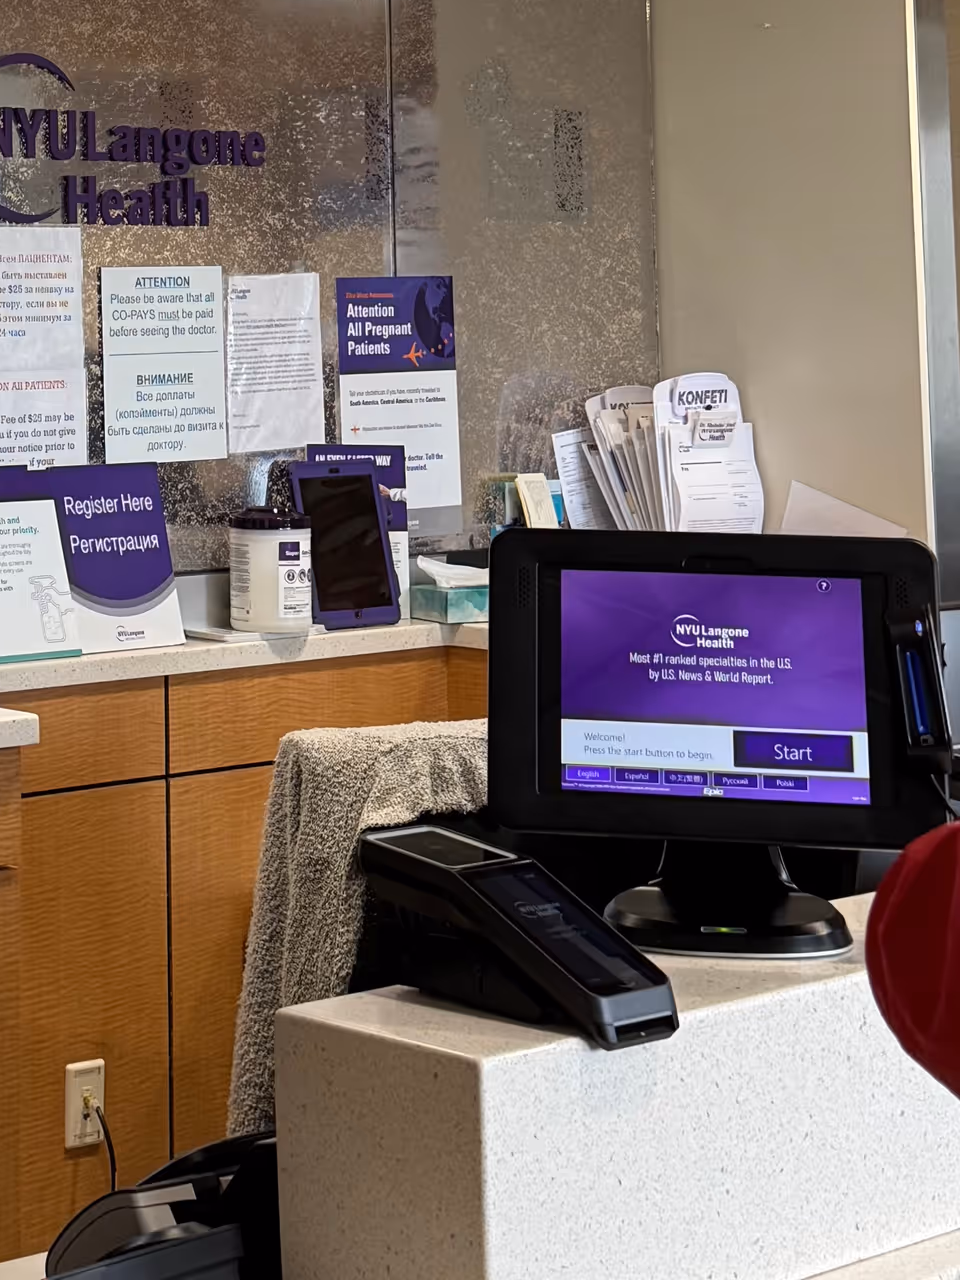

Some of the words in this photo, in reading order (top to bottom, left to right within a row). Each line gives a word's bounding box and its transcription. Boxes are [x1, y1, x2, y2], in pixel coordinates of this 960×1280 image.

[79, 110, 266, 176] Langone
[60, 175, 209, 227] Health
[1, 270, 23, 280] быть
[134, 276, 191, 289] ATTENTION
[110, 293, 141, 305] Please
[143, 293, 155, 304] be
[157, 293, 185, 303] aware
[186, 291, 203, 303] that
[204, 291, 215, 302] all
[112, 308, 156, 321] CO-PAYS
[157, 308, 180, 321] must
[181, 308, 193, 319] be
[195, 308, 214, 322] paid
[346, 303, 395, 318] Attention
[8, 329, 26, 338] часа
[109, 325, 138, 338] before
[140, 324, 170, 338] seeing
[171, 324, 186, 335] the
[187, 323, 217, 335] doctor.
[347, 322, 362, 337] All
[365, 322, 412, 339] Pregnant
[347, 340, 391, 356] Patients
[136, 372, 194, 386] ВНИМАНИЕ
[135, 390, 154, 402] Все
[155, 390, 195, 403] доплаты
[677, 388, 728, 406] KONFETI
[179, 405, 216, 417] должны
[0, 415, 16, 424] Fee
[17, 413, 27, 423] of
[44, 414, 61, 425] may
[63, 412, 75, 422] be
[6, 429, 14, 439] if
[14, 430, 30, 442] you
[30, 428, 42, 438] do
[43, 428, 57, 438] not
[58, 427, 76, 439] give
[107, 425, 131, 437] быть
[132, 424, 173, 437] сделаны
[173, 423, 186, 434] до
[187, 422, 217, 432] визита
[218, 421, 224, 430] к
[17, 443, 43, 453] notice
[44, 442, 66, 454] prior
[67, 441, 75, 451] to
[147, 440, 187, 453] доктору.
[36, 458, 55, 468] your
[375, 455, 392, 467] WAY
[63, 495, 119, 519] Register
[121, 493, 153, 512] Here
[7, 516, 21, 525] and
[0, 528, 11, 536] our
[12, 525, 40, 537] priority.
[69, 533, 160, 556] Регистрация
[676, 623, 700, 636] NYU
[701, 625, 749, 639] Langone
[696, 636, 735, 649] Health
[629, 652, 650, 664] Most
[652, 653, 663, 664] #1
[665, 654, 697, 665] ranked
[698, 655, 747, 668] specialties
[749, 656, 758, 668] in
[760, 657, 775, 669] the
[776, 658, 793, 670] U.S.
[648, 668, 660, 682] by
[661, 669, 677, 680] U.S.
[678, 670, 703, 682] News
[704, 671, 712, 682] &
[713, 671, 739, 683] World
[741, 672, 774, 685] Report.
[583, 732, 626, 743] Welcome!
[583, 745, 606, 756] Press
[607, 746, 622, 756] the
[623, 747, 643, 757] start
[644, 747, 675, 758] button
[676, 749, 685, 759] to
[773, 743, 813, 762] Start
[577, 769, 600, 779] English
[722, 776, 749, 786] Русский
[776, 779, 795, 788] Polski
[703, 787, 724, 797] Epic
